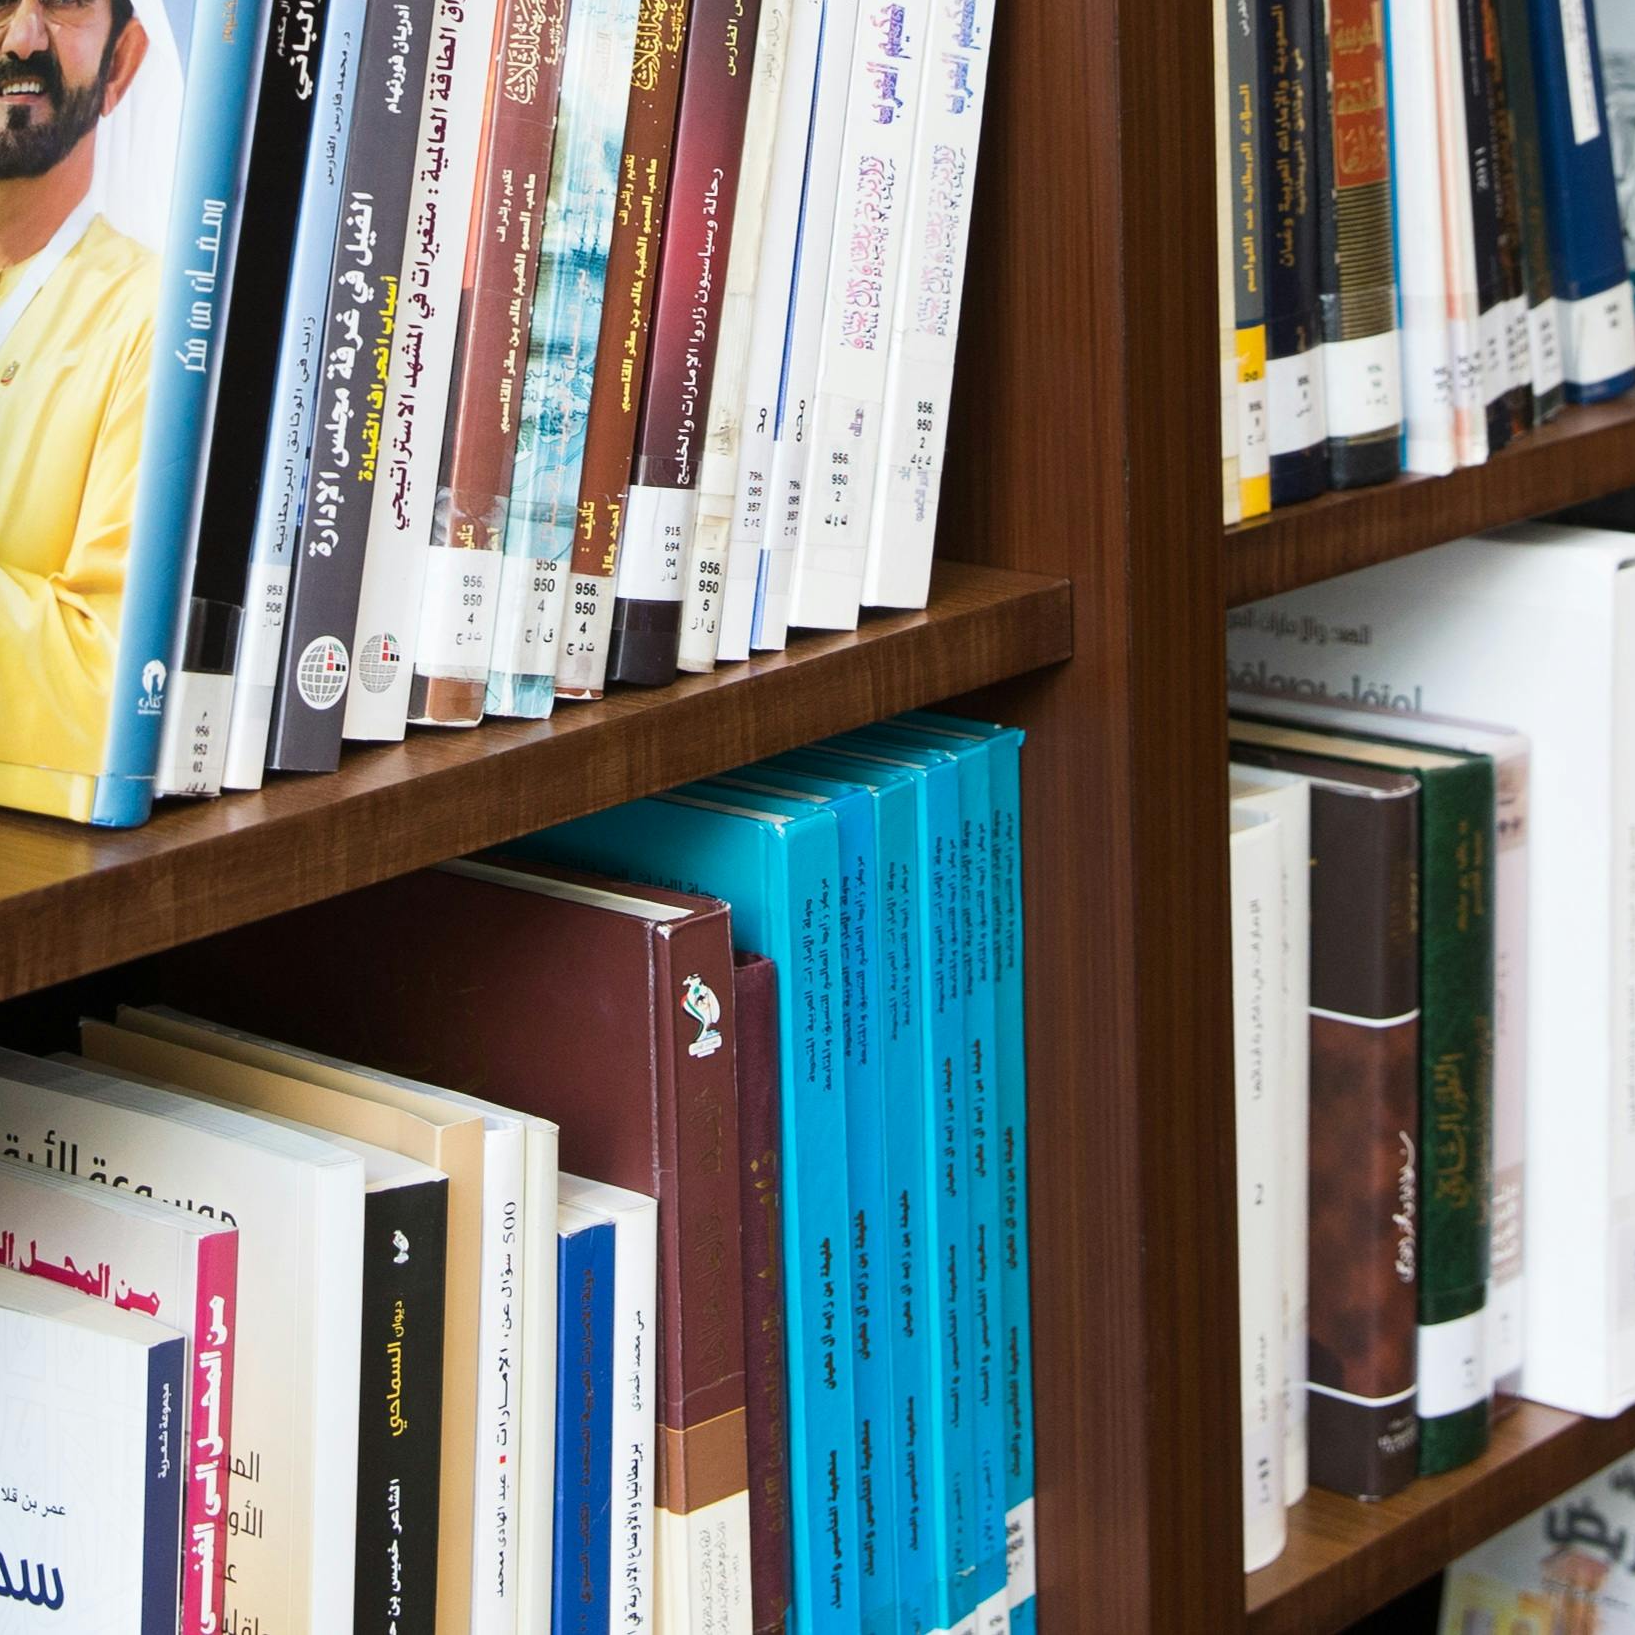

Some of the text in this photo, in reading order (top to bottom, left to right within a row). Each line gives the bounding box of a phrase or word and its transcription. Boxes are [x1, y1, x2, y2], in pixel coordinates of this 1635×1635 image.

[394, 5, 412, 53] أدريان
[725, 19, 738, 76] الفارس
[338, 50, 349, 90] محمد
[429, 28, 457, 101] الطاقة
[333, 93, 345, 132] فارس
[326, 135, 339, 186] الفارس
[419, 108, 448, 182] العالمية
[411, 202, 438, 287] متغيرات
[517, 212, 532, 250] السمو
[511, 254, 527, 295] الشيخ
[187, 302, 212, 329] من
[409, 293, 435, 319] في
[300, 315, 315, 354] زايد
[508, 329, 521, 346] بن
[674, 169, 722, 485] رحالة وسياسيون زاروا الإمارات والخليج
[175, 338, 208, 373] فكر
[299, 359, 312, 383] في
[308, 192, 376, 556] الفيل في غرفة مجلس الإدارة
[403, 325, 423, 388] المشهد
[359, 275, 398, 481] أسباب انحراف القيادة
[917, 419, 932, 431] 950
[390, 395, 415, 530] الاستراتيجي
[831, 474, 848, 485] 950
[273, 460, 295, 553] البريطانية
[835, 492, 841, 502] 2
[534, 579, 555, 592] 950
[537, 599, 545, 612] 4
[699, 580, 719, 594] 950
[703, 599, 710, 611] 5
[575, 602, 596, 615] 950
[579, 622, 587, 634] 4
[206, 1295, 227, 1345] من
[386, 1301, 407, 1436] ديوان السماحي
[197, 1351, 222, 1457] المحل
[158, 1383, 171, 1478] مجموعة شعرية
[196, 1460, 221, 1516] إلى
[627, 1443, 643, 1499] بريطانيا
[21, 1494, 37, 1511] بن
[41, 1505, 66, 1517] عمر
[387, 1479, 402, 1616] الشاعر خميس بن
